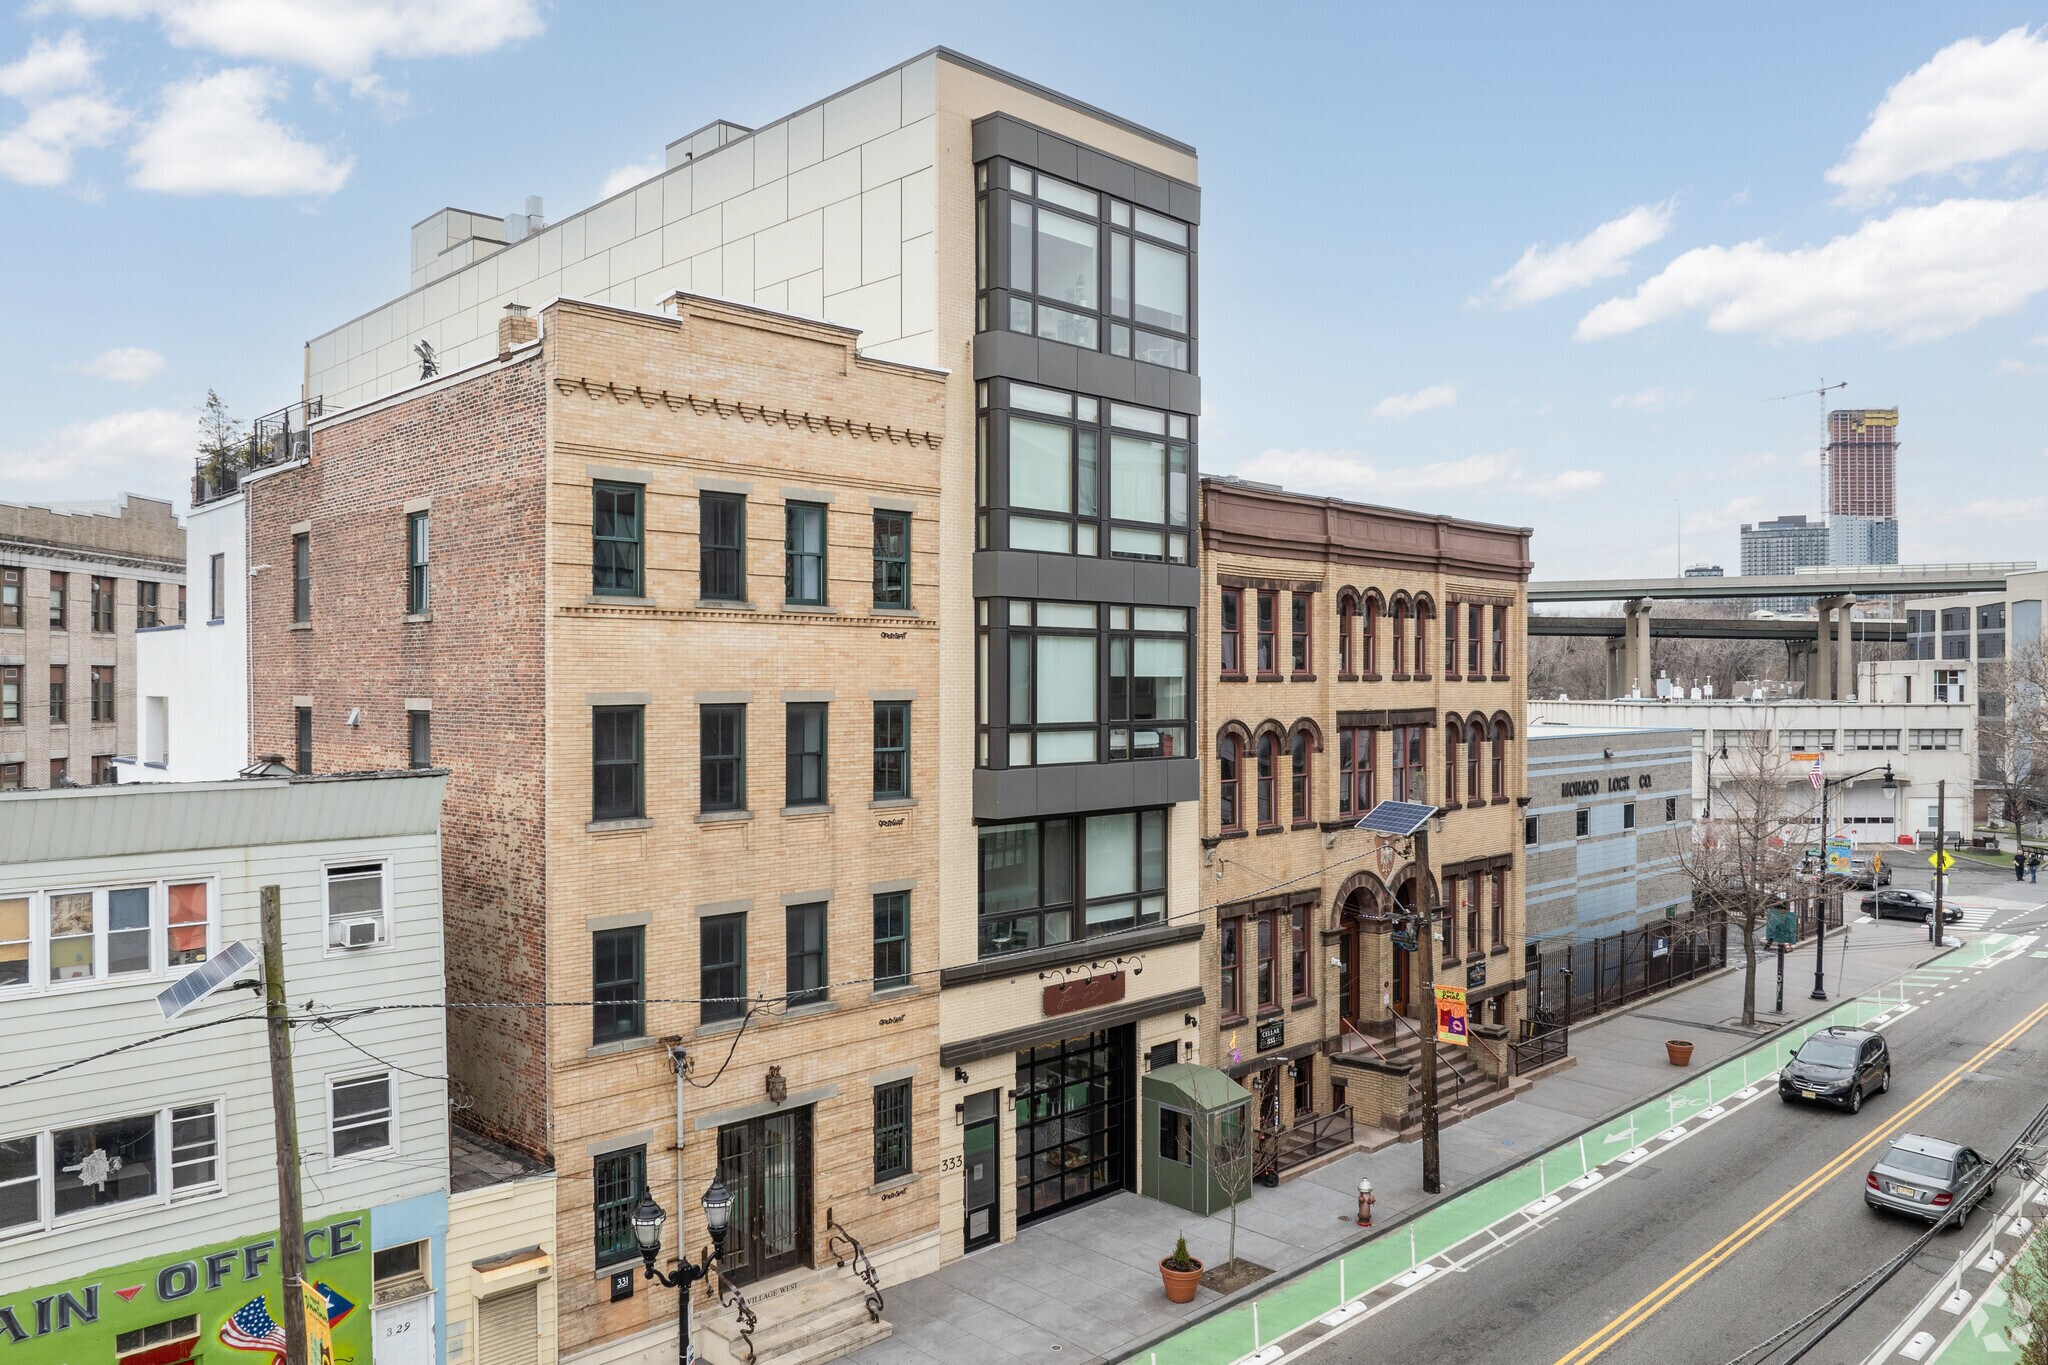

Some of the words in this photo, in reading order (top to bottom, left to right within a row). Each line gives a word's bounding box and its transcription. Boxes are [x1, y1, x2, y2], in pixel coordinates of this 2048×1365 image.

[1561, 779, 1600, 798] MONACO
[1608, 775, 1630, 793] LOCK
[941, 1154, 963, 1172] 333
[156, 1216, 362, 1301] OFFCE
[616, 1275, 629, 1289] 331
[747, 1289, 779, 1305] VILLAGE
[780, 1282, 799, 1294] WEST
[386, 1321, 411, 1337] 329
